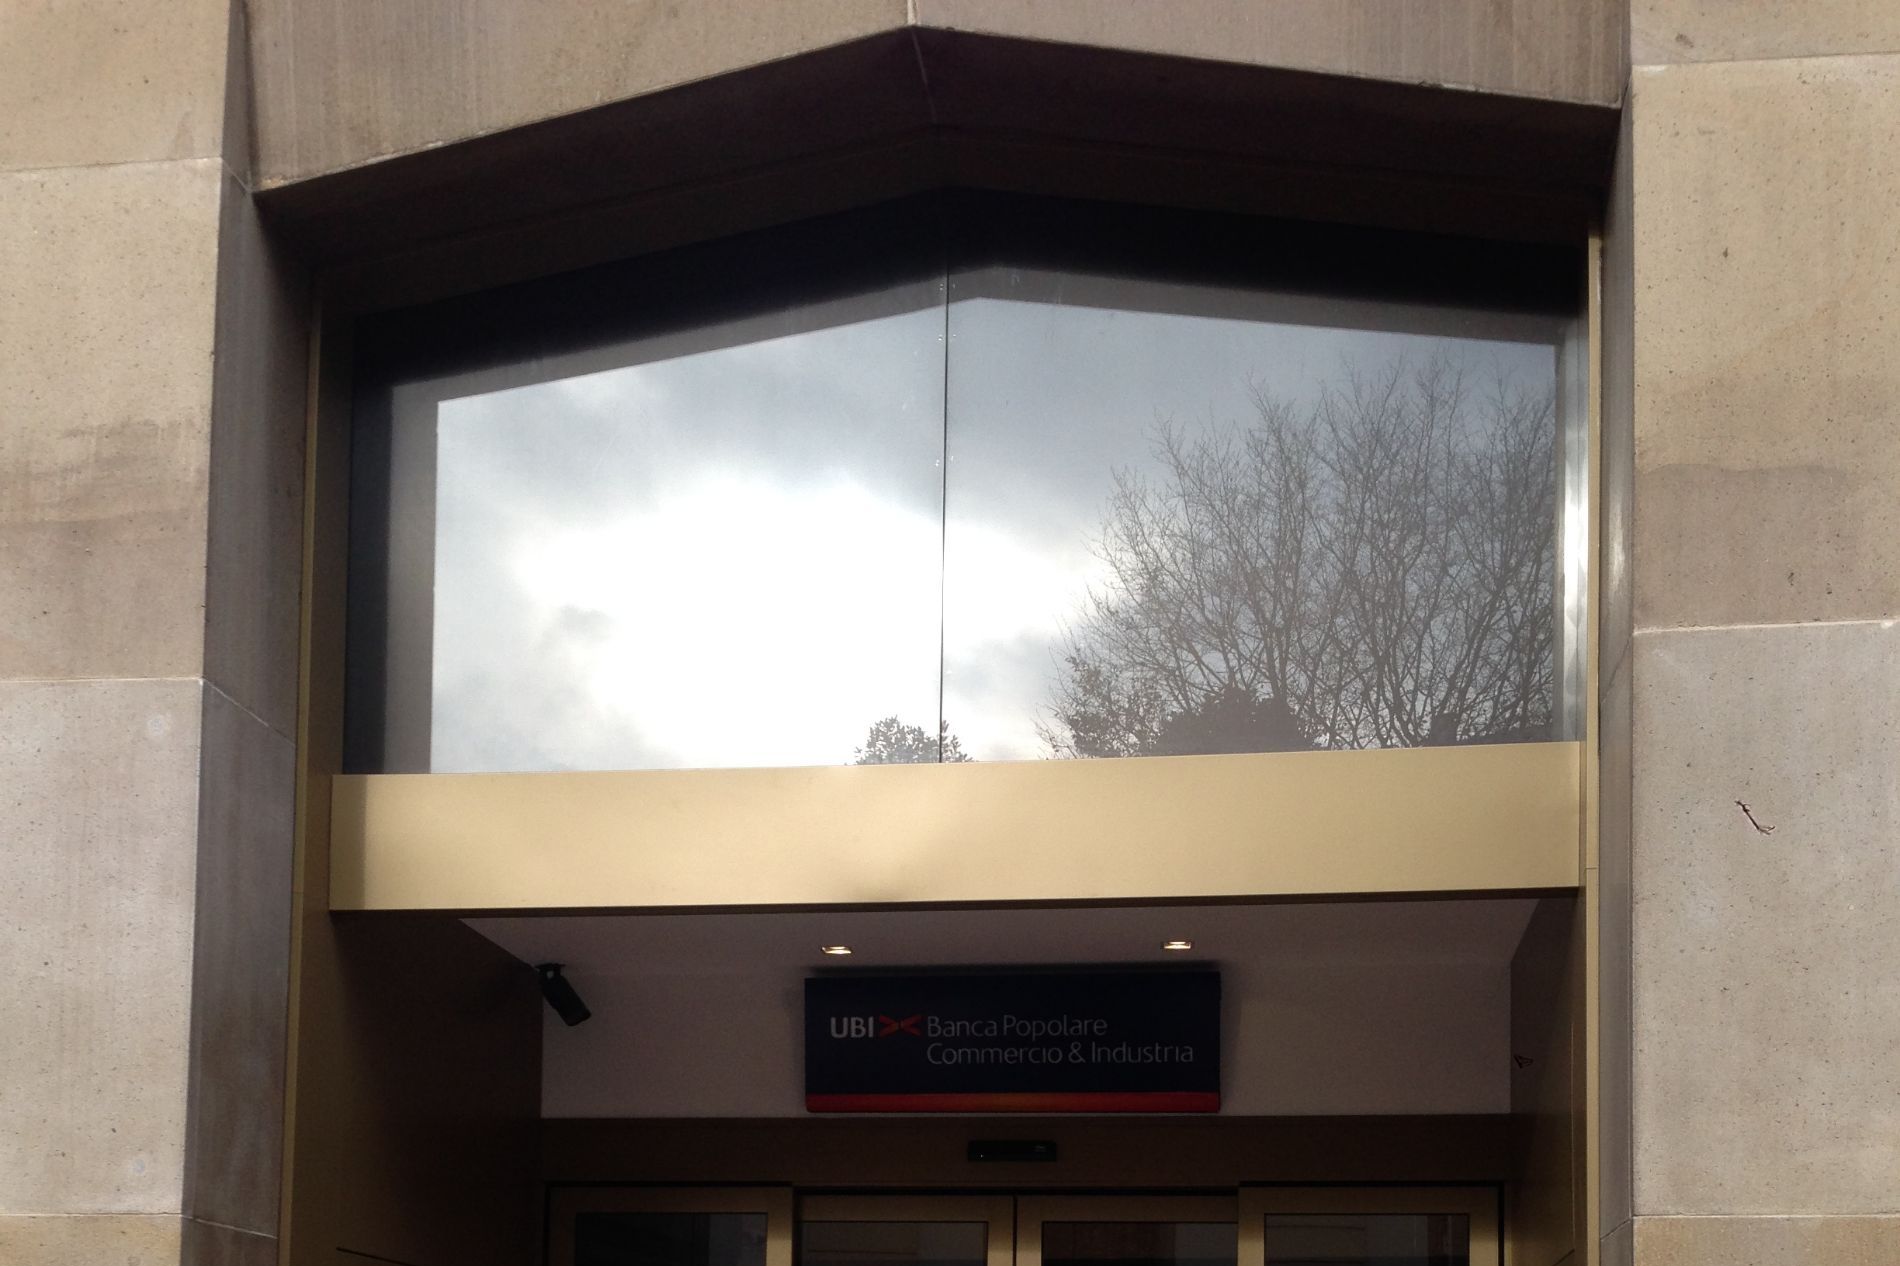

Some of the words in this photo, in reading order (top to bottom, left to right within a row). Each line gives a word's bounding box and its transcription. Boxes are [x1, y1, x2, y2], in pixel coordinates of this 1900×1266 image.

[830, 1016, 874, 1039] UBI
[927, 1016, 999, 1038] Banca
[1003, 1015, 1108, 1042] Popolare
[927, 1042, 1062, 1065] Commercio
[1068, 1042, 1086, 1064] &
[1091, 1041, 1194, 1064] Industria
